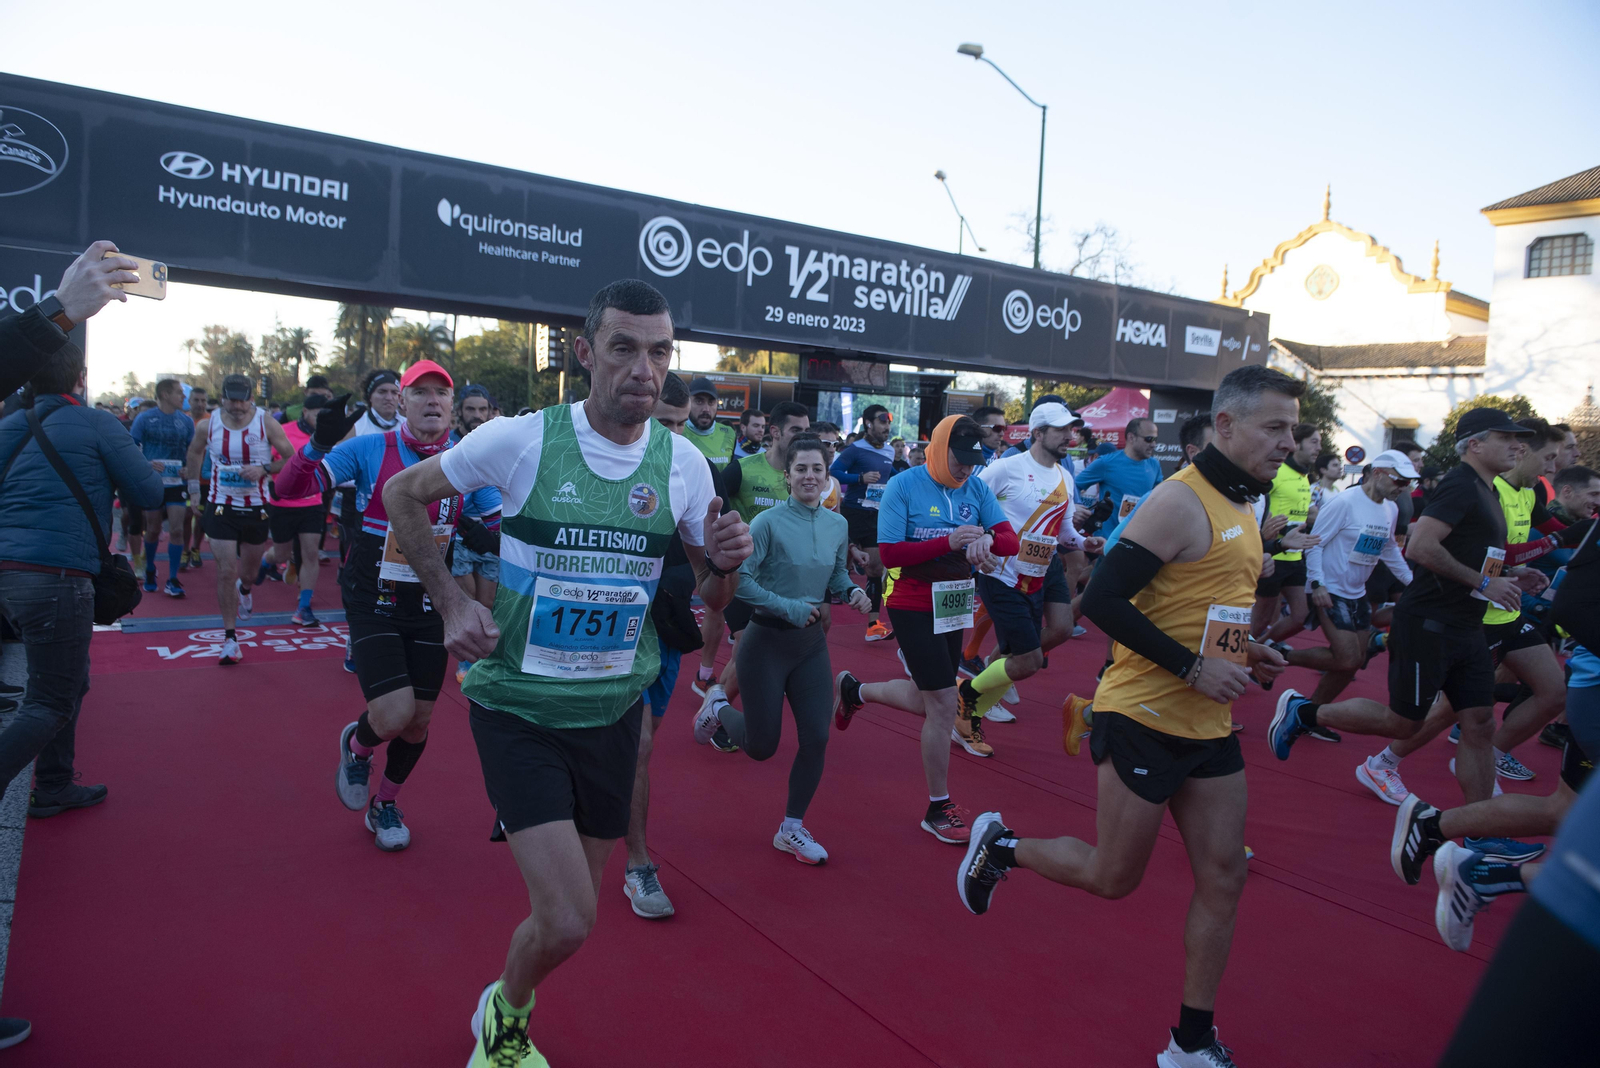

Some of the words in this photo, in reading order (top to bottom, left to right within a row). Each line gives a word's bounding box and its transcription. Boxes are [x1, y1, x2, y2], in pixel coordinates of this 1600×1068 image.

[221, 162, 349, 201] HYUNDAI
[158, 185, 281, 219] Hyundauto
[286, 204, 347, 229] Motor
[459, 213, 583, 247] quirónsalud
[478, 241, 539, 262] Healthcare
[541, 251, 581, 268] Partner
[696, 229, 773, 286] edp
[823, 250, 945, 294] maratón
[853, 284, 945, 320] sevilla
[764, 305, 784, 323] 29
[787, 312, 830, 328] enero
[832, 315, 866, 333] 2023
[1036, 298, 1082, 340] edp
[1115, 318, 1167, 347] HOKA
[754, 496, 775, 506] MEDIO
[554, 527, 648, 553] ATLETISMO
[1221, 525, 1244, 542] HOKA
[1363, 537, 1383, 550] 1708
[535, 551, 655, 578] TORREMOLINOS
[1025, 543, 1051, 559] 3932
[563, 587, 584, 599] edp
[598, 590, 632, 598] maratón
[941, 592, 967, 610] 4993
[551, 606, 619, 637] 1751
[548, 641, 579, 651] Alejandro
[580, 643, 600, 651] Cortés
[581, 652, 599, 662] edp
[967, 844, 990, 878] HOKA
